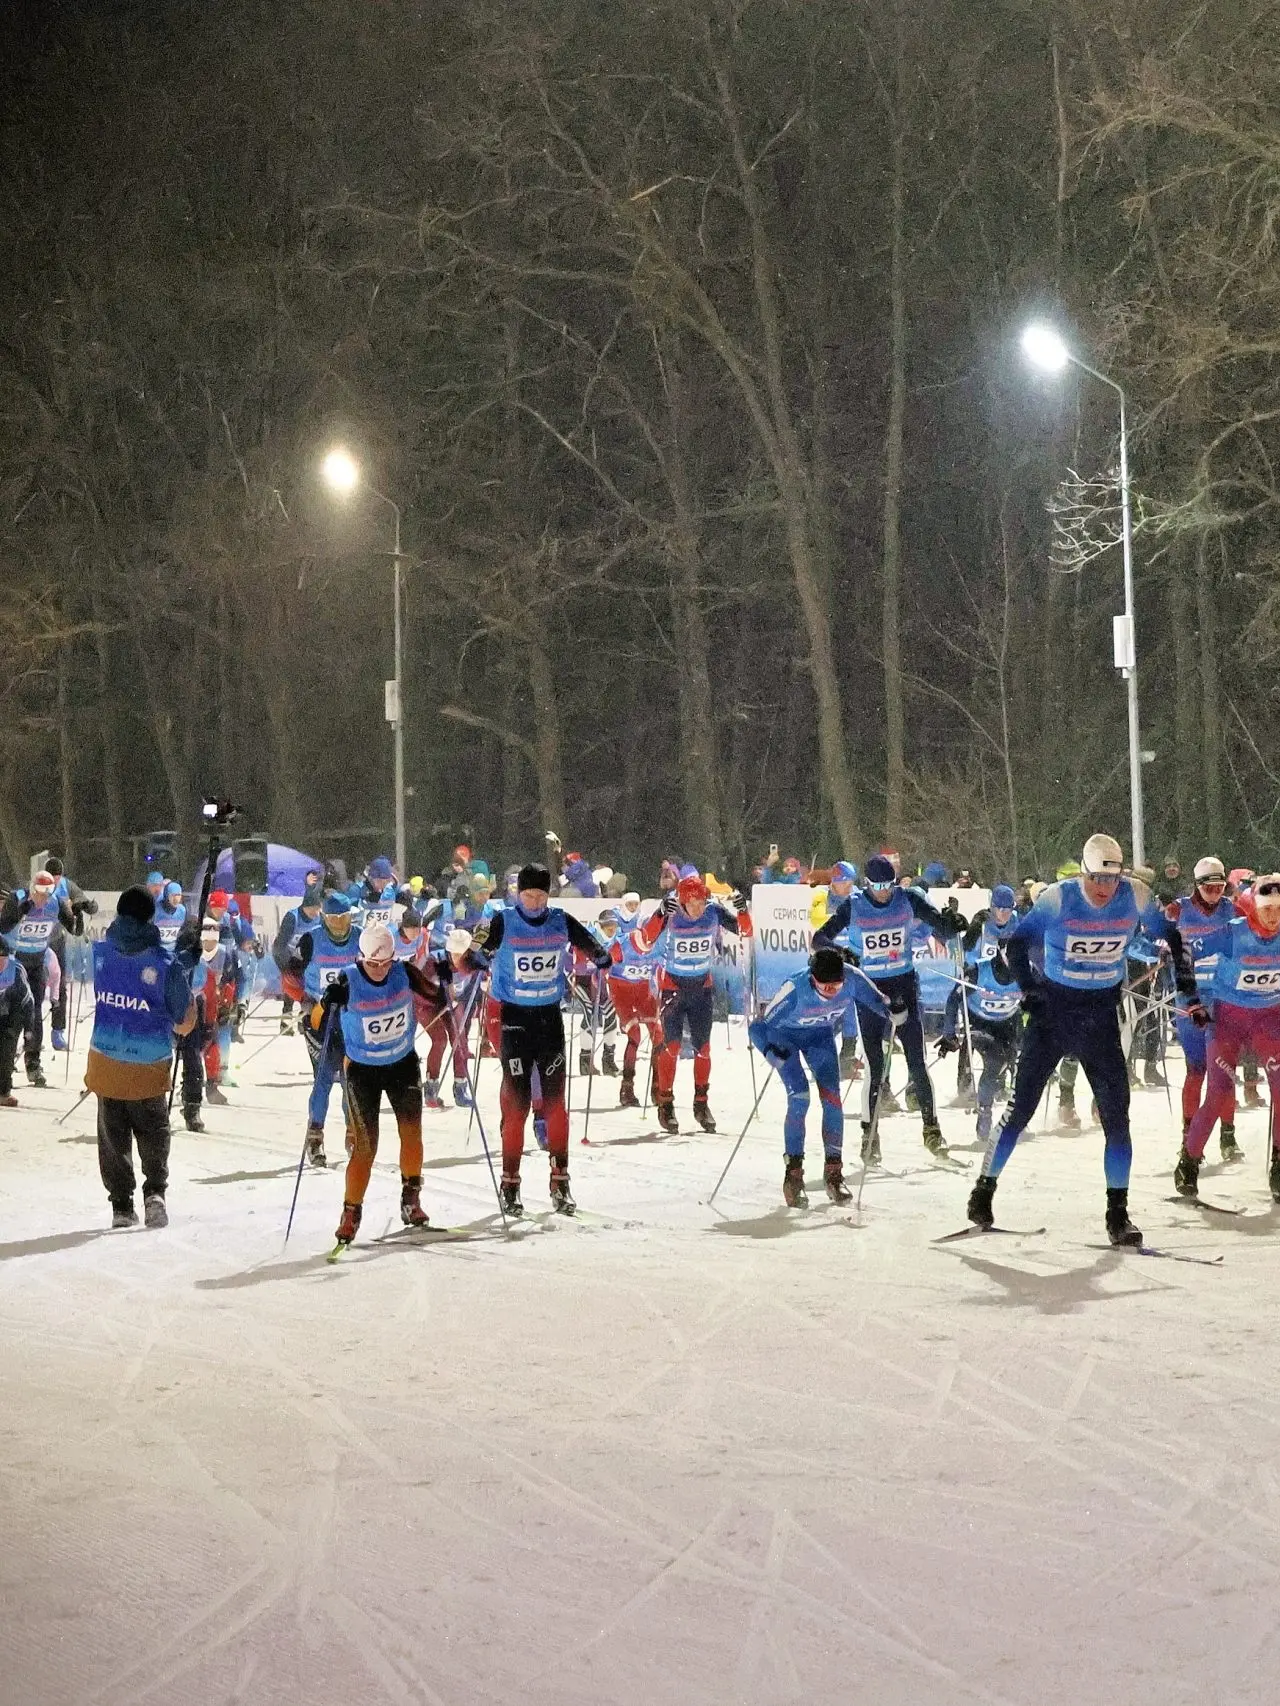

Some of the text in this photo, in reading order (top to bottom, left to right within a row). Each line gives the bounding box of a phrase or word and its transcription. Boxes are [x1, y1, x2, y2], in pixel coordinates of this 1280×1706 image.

[773, 908, 797, 920] СЕРИЯ
[23, 923, 48, 933] 615
[676, 939, 709, 953] 689
[865, 931, 902, 949] 685
[1071, 941, 1122, 954] 677
[517, 955, 557, 972] 664
[368, 1012, 406, 1034] 672
